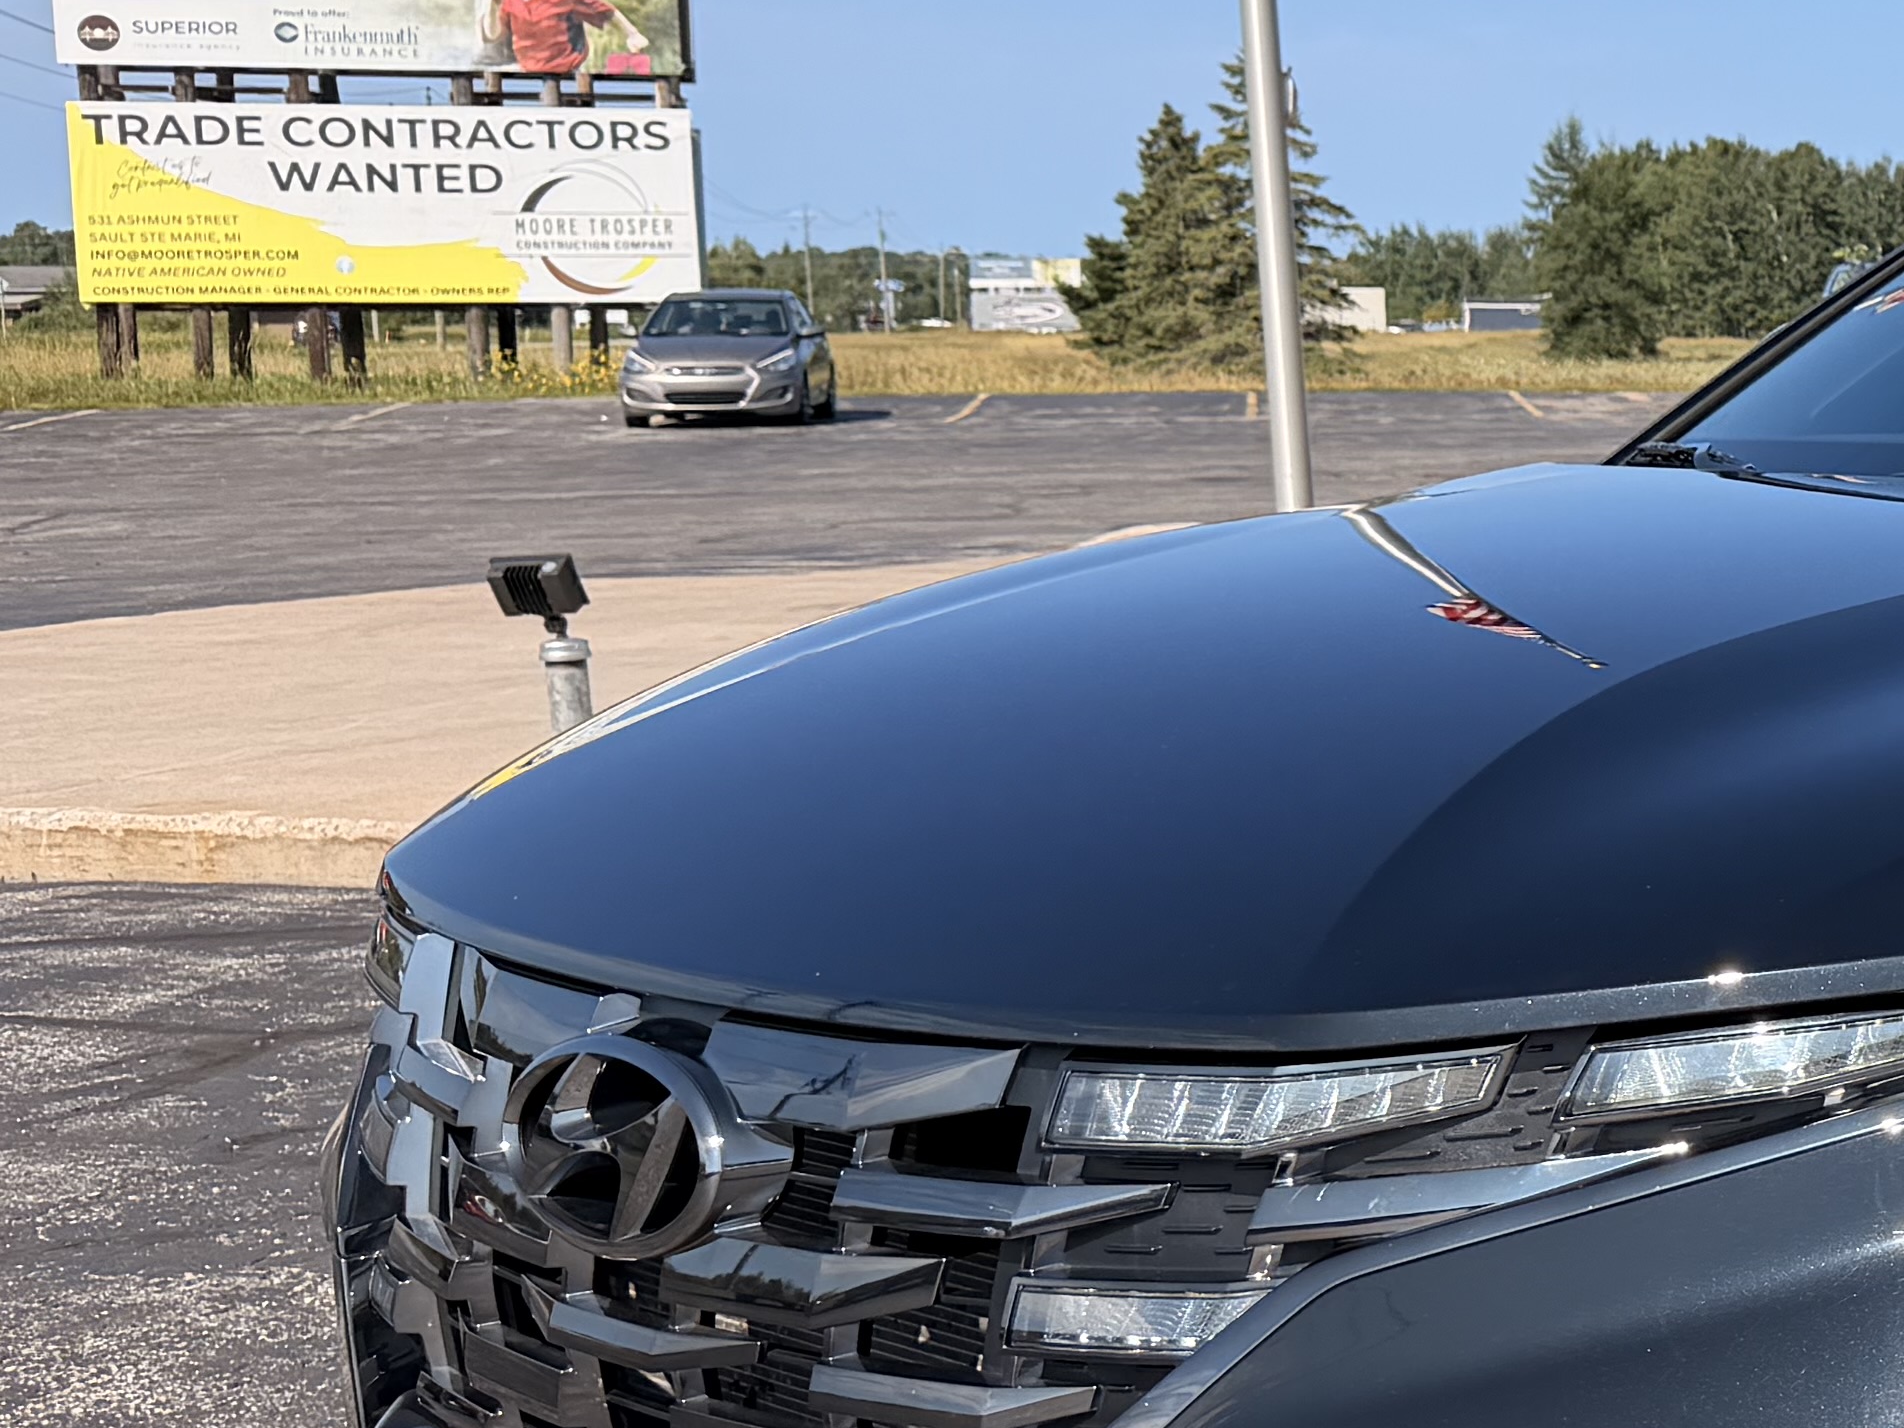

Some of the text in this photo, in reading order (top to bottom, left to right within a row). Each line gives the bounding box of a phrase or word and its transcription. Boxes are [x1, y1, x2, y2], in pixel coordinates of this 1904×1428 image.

[273, 8, 304, 17] Proud
[307, 9, 318, 17] to
[132, 20, 238, 35] SUPERIOR
[304, 23, 418, 45] Frankenmuth
[304, 46, 420, 58] INSURANCE
[81, 114, 671, 151] TRADE CONTRACTORS
[267, 161, 503, 194] WANTED
[116, 215, 183, 225] ASHMUN
[186, 215, 239, 226] STREET
[515, 218, 673, 236] MOORE TROSPER
[89, 232, 135, 243] SAULT
[139, 232, 166, 243] STE
[224, 233, 241, 243] MI
[516, 240, 673, 251] CONSTRUCTION COMPANY
[90, 250, 299, 261] INFO@MOORETROSPER.COM
[91, 267, 287, 278] NATIVE AMERICAN OWNED
[93, 286, 194, 296] CONSTRUCTION
[199, 286, 262, 295] MANAGER
[273, 286, 331, 296] GENERAL
[335, 286, 420, 296] CONTRACTOR
